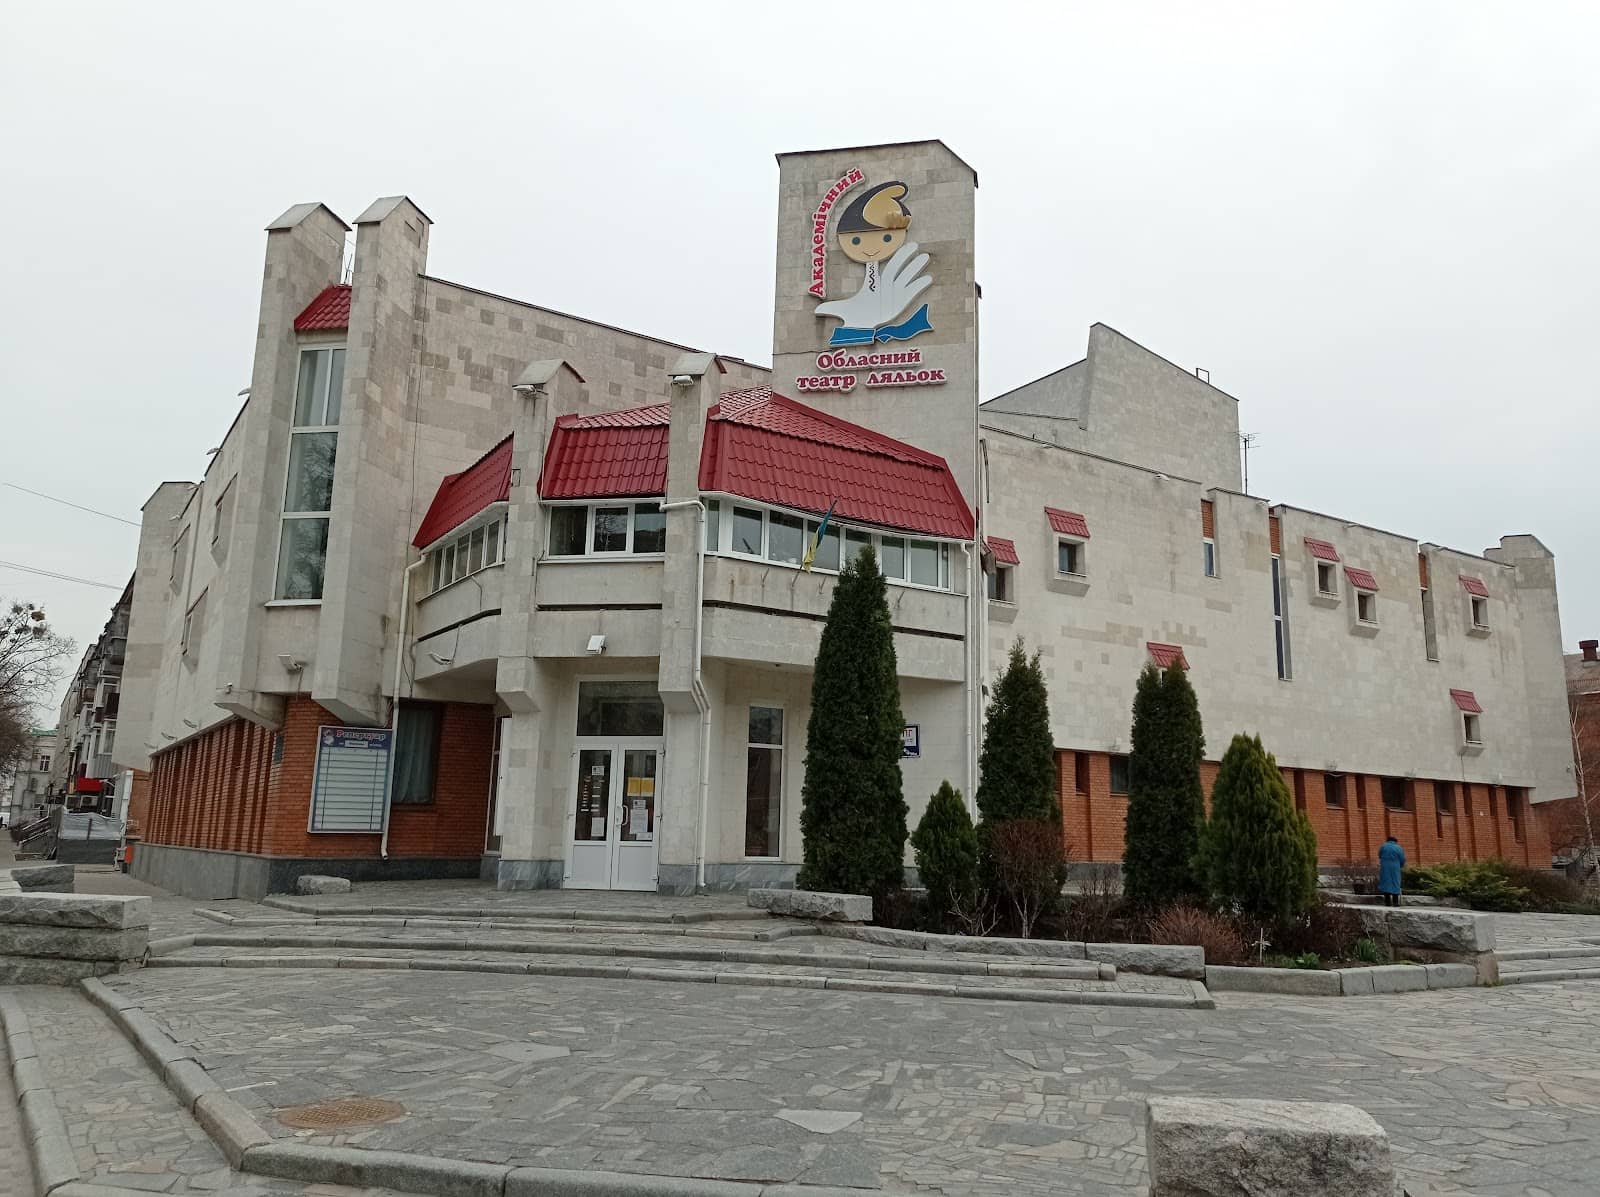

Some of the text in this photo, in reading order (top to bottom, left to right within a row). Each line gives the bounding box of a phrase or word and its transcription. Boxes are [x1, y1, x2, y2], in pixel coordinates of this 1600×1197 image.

[809, 168, 864, 297] Академічний
[816, 349, 922, 370] Обласний
[796, 368, 946, 390] театр ляльок
